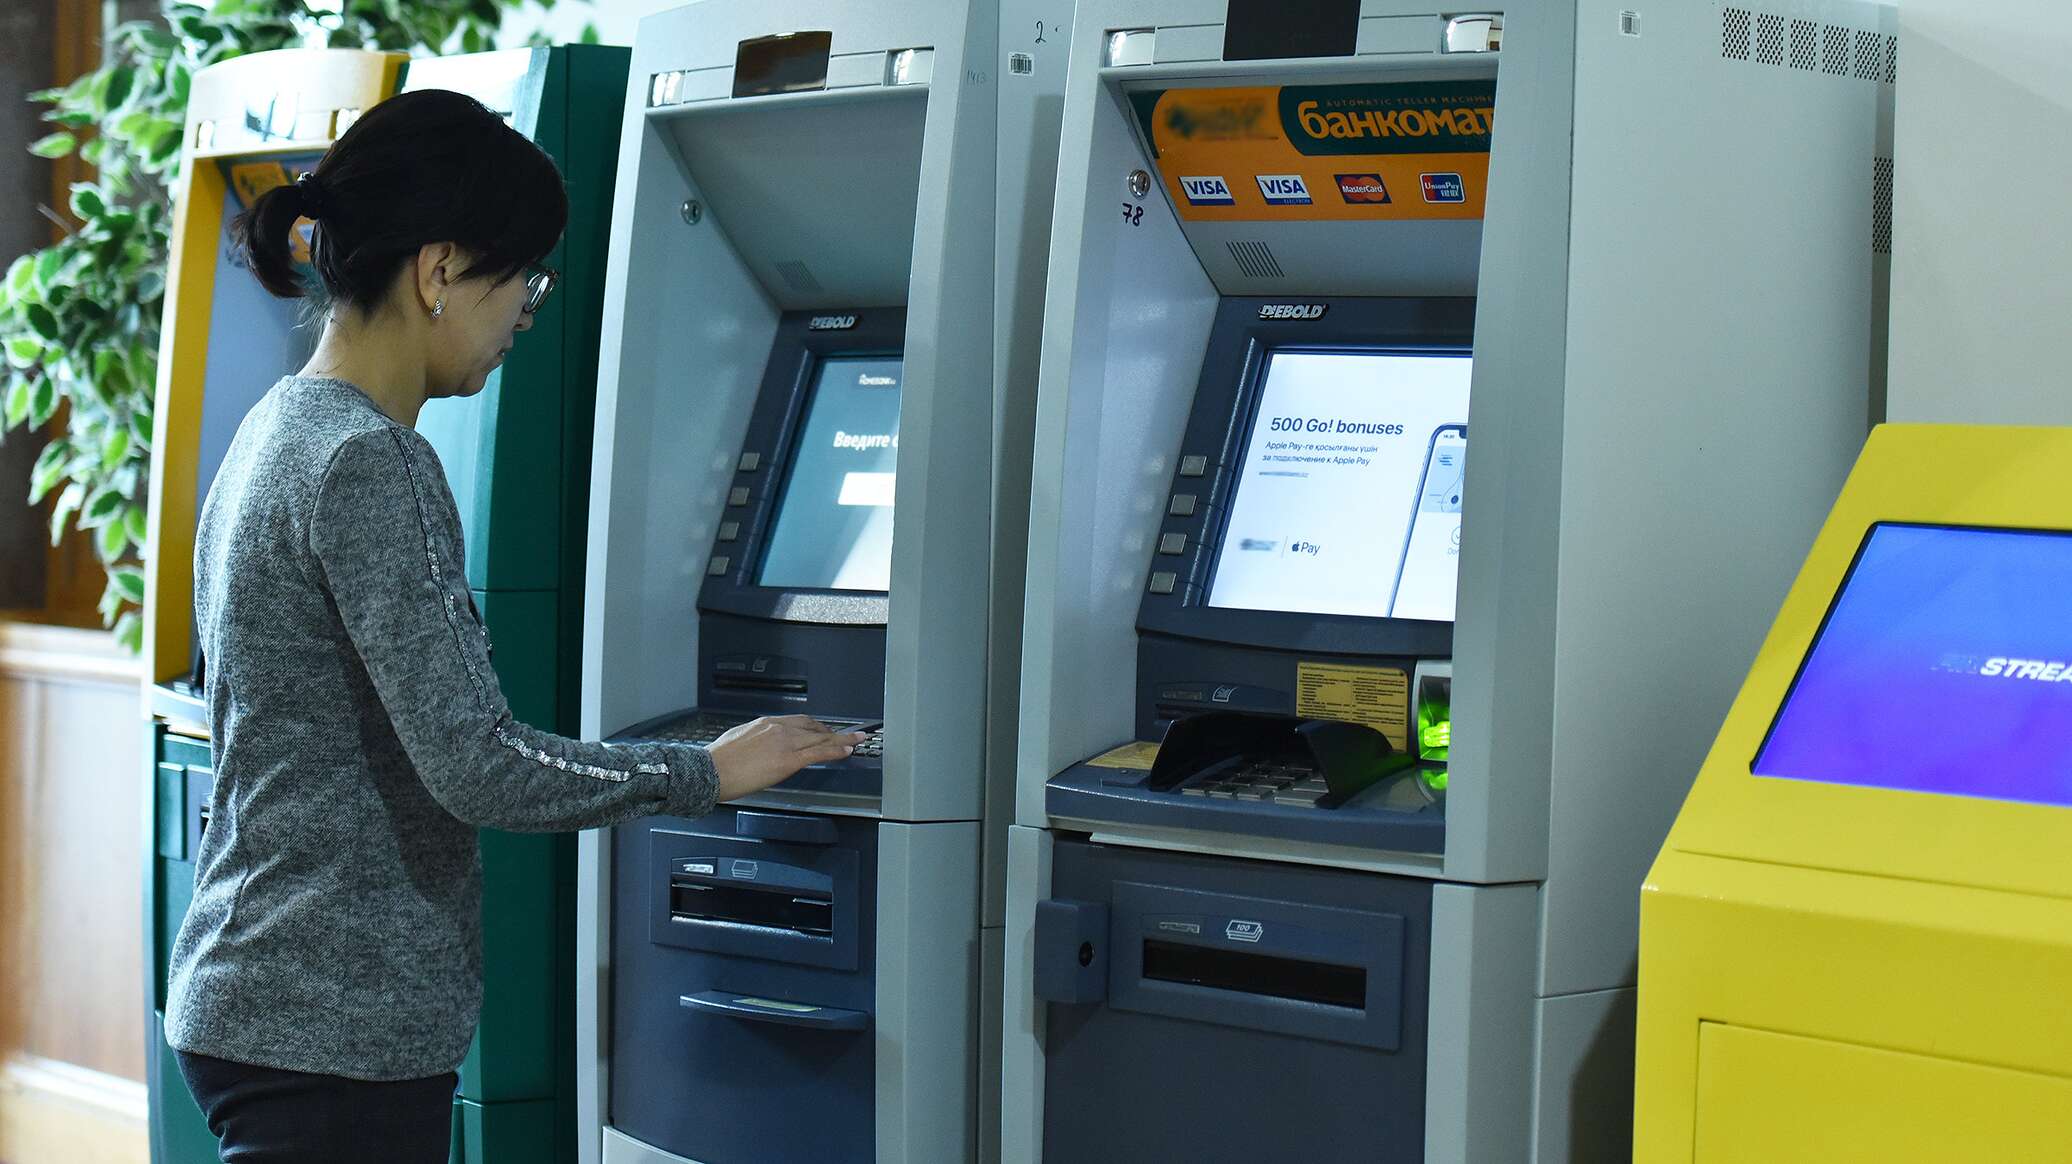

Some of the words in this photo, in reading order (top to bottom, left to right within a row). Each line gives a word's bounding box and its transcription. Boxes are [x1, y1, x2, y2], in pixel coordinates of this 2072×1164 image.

[1298, 101, 1494, 139] банкомат
[1185, 180, 1228, 195] VISA
[1262, 179, 1306, 194] VISA
[1342, 184, 1383, 193] MasterCard
[1425, 182, 1459, 191] UnionPay
[1122, 202, 1144, 227] 78
[1258, 305, 1325, 318] DIEBOLD
[1270, 417, 1303, 432] 500
[1306, 418, 1334, 433] Go!
[1336, 419, 1404, 435] bonuses
[833, 431, 890, 451] Введите
[1265, 441, 1287, 451] Apple
[1333, 457, 1355, 465] Apple
[1356, 457, 1371, 466] Pay
[1301, 542, 1321, 556] Pay
